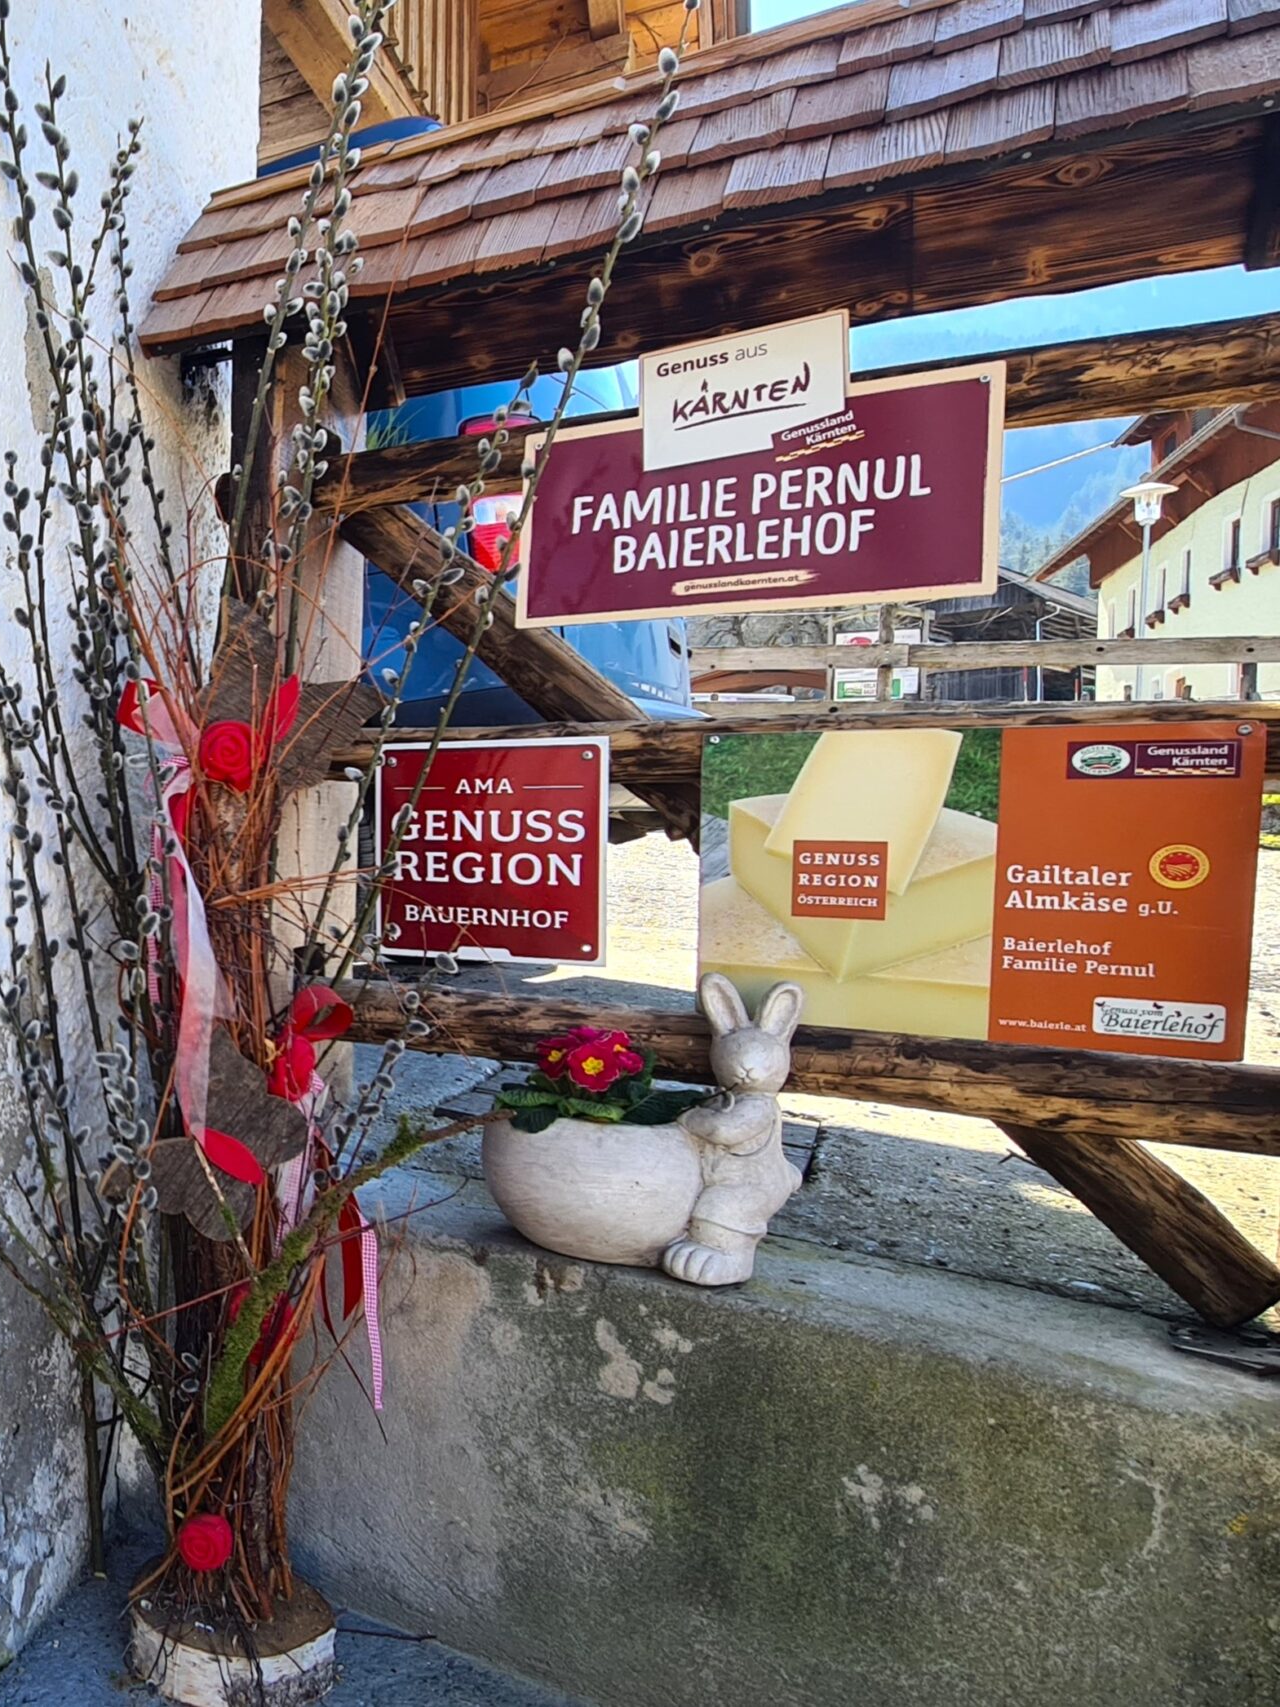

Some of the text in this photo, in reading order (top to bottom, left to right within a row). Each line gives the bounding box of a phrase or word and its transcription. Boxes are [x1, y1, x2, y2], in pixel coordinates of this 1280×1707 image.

[656, 343, 768, 377] Genuss aus
[672, 362, 811, 423] KÄRNTEN
[781, 410, 854, 442] Genussland
[806, 422, 857, 446] Kärnten
[571, 454, 931, 535] FAMILIE PERNUL
[613, 508, 875, 574] BAIERLEHOF
[684, 575, 799, 592] genusslandkaernten.at
[1147, 745, 1228, 756] Genussland
[1172, 757, 1228, 766] Kärnten
[455, 778, 513, 794] AMA
[391, 809, 586, 842] GENUSS
[393, 850, 582, 886] REGION
[798, 852, 880, 867] GENUSS
[798, 873, 879, 888] REGION
[1006, 864, 1132, 887] Gailtaler
[797, 893, 878, 907] ÖSTERREICH
[1004, 889, 1179, 917] Almkäse g.U.
[404, 904, 569, 929] BAUERNHOF
[1002, 936, 1112, 955] Baierlehof
[1002, 955, 1156, 978] Familie Pernul
[998, 1017, 1087, 1032] www.baierle.at
[1101, 1012, 1225, 1041] Baierlehof
